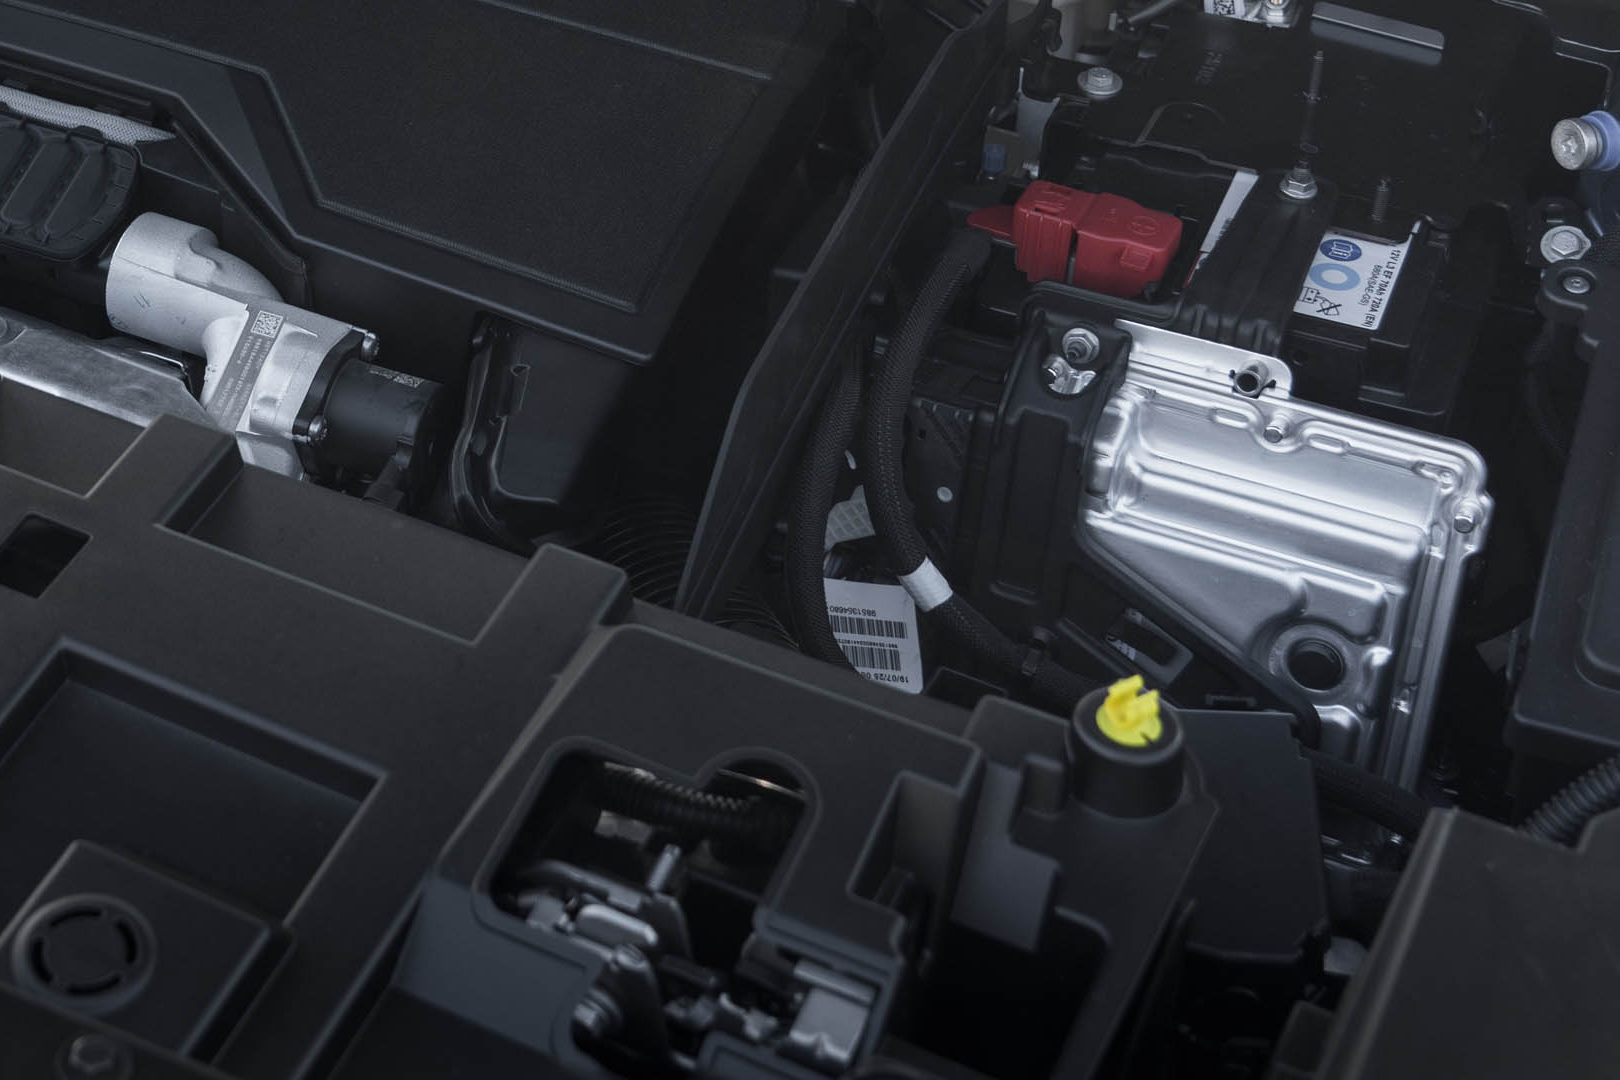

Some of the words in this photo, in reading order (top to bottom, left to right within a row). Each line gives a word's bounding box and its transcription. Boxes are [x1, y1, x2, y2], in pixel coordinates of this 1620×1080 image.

[1389, 249, 1401, 261] 12V
[1375, 280, 1390, 296] 70Ah
[1368, 296, 1383, 313] 720A
[1361, 313, 1376, 328] (EN)
